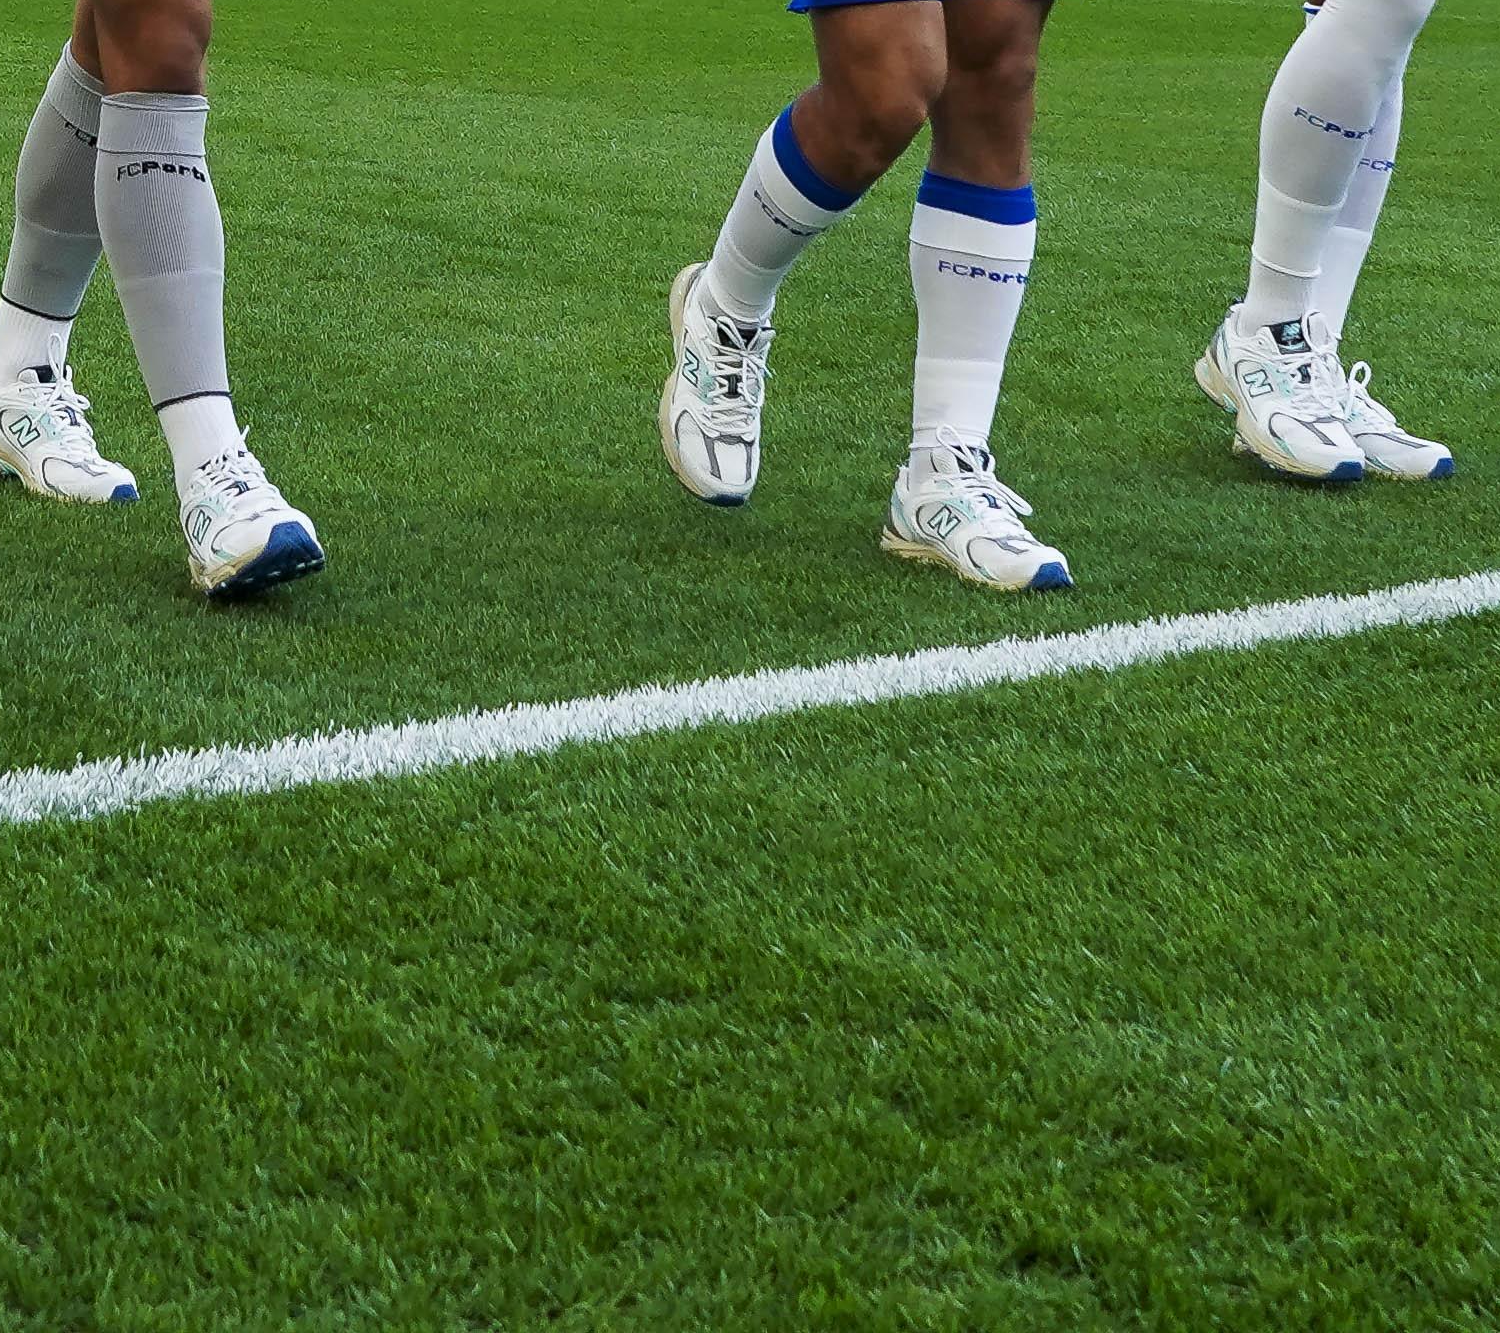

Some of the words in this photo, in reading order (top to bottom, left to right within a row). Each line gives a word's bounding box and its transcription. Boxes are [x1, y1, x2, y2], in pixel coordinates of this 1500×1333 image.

[116, 160, 207, 183] FCPort
[1243, 369, 1274, 398] N
[9, 415, 40, 448] N
[929, 505, 961, 539] N
